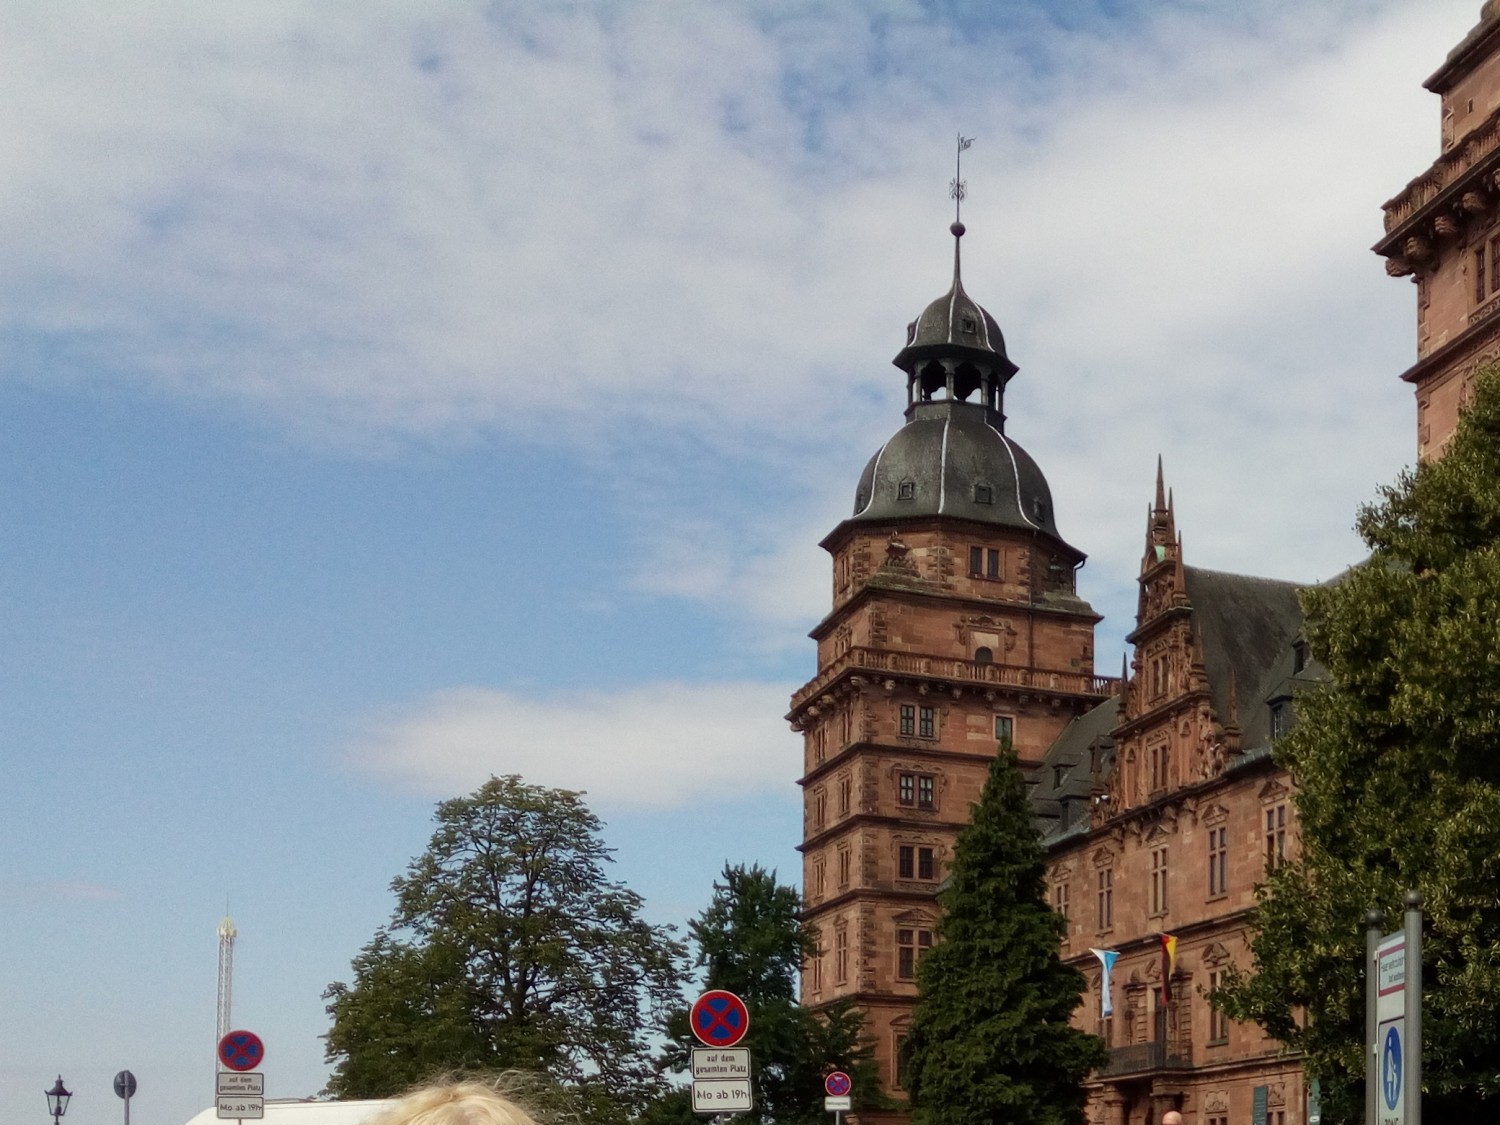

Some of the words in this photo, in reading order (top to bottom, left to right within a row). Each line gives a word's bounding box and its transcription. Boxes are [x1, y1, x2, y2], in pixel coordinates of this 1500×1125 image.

[707, 1054, 717, 1062] auf
[721, 1054, 735, 1062] dem
[696, 1065, 727, 1075] gesamten
[730, 1064, 746, 1073] Platz
[697, 1090, 712, 1099] Mo
[716, 1090, 728, 1099] ab
[731, 1089, 747, 1099] 19h
